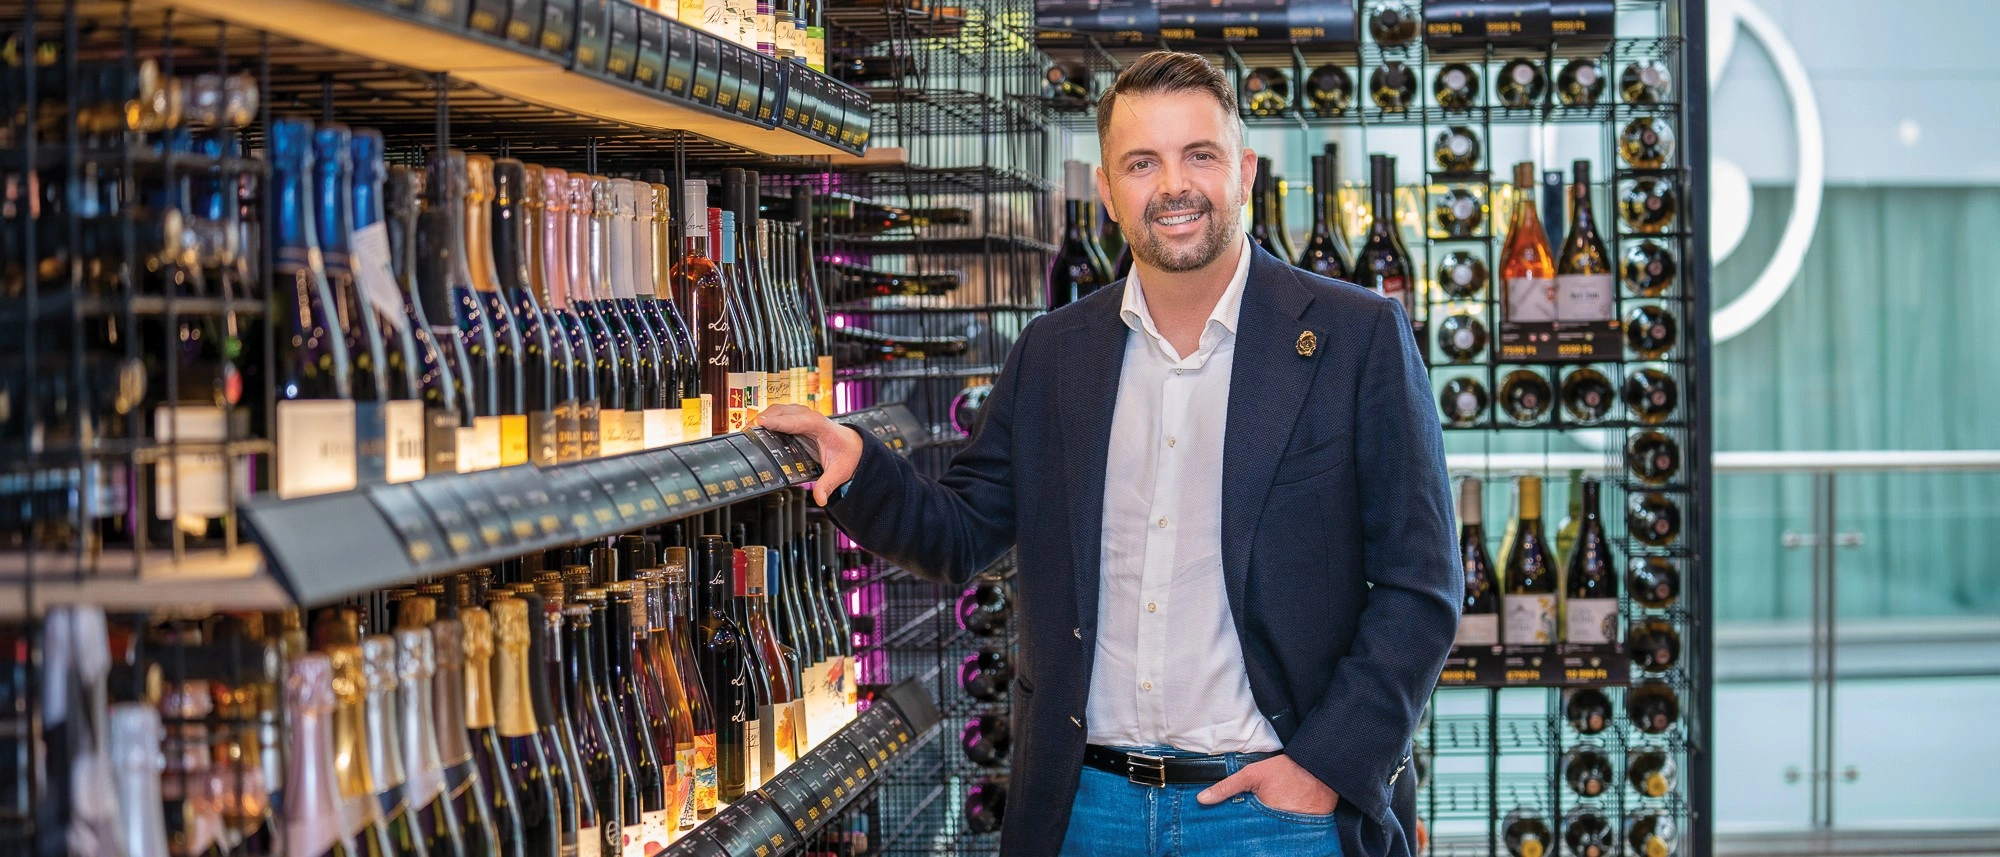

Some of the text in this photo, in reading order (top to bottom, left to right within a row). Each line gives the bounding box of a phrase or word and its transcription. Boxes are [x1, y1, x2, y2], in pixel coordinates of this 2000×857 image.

[1451, 22, 1463, 33] Ft
[1510, 21, 1521, 32] Ft
[1574, 20, 1586, 31] Ft
[1247, 27, 1259, 37] Ft
[1313, 27, 1325, 37] Ft
[1525, 345, 1537, 355] Ft
[1582, 344, 1593, 354] Ft
[1596, 668, 1608, 680] Ft
